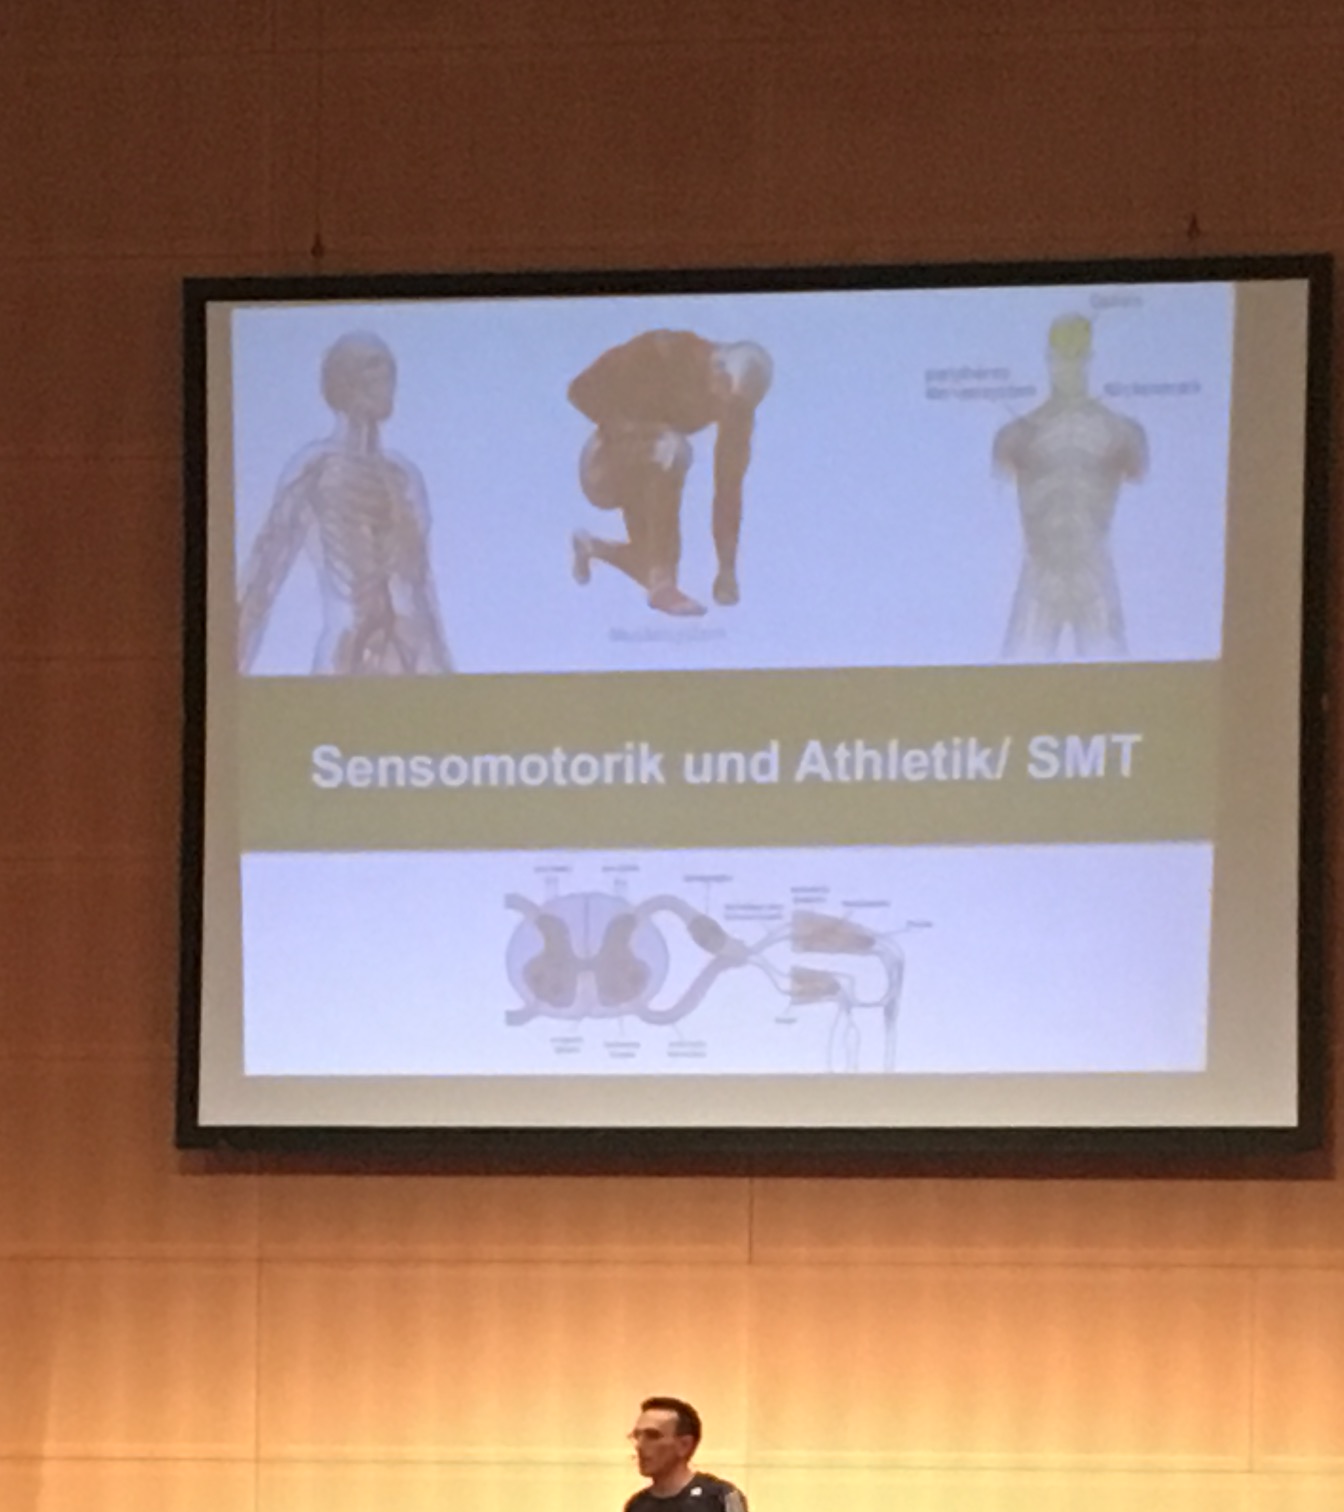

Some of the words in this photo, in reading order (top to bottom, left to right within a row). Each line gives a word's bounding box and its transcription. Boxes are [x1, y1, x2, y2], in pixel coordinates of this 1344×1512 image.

[311, 742, 665, 789] Sensomotorik
[682, 739, 780, 785] und
[794, 736, 1013, 784] Athletik/
[1026, 733, 1144, 780] SMT
